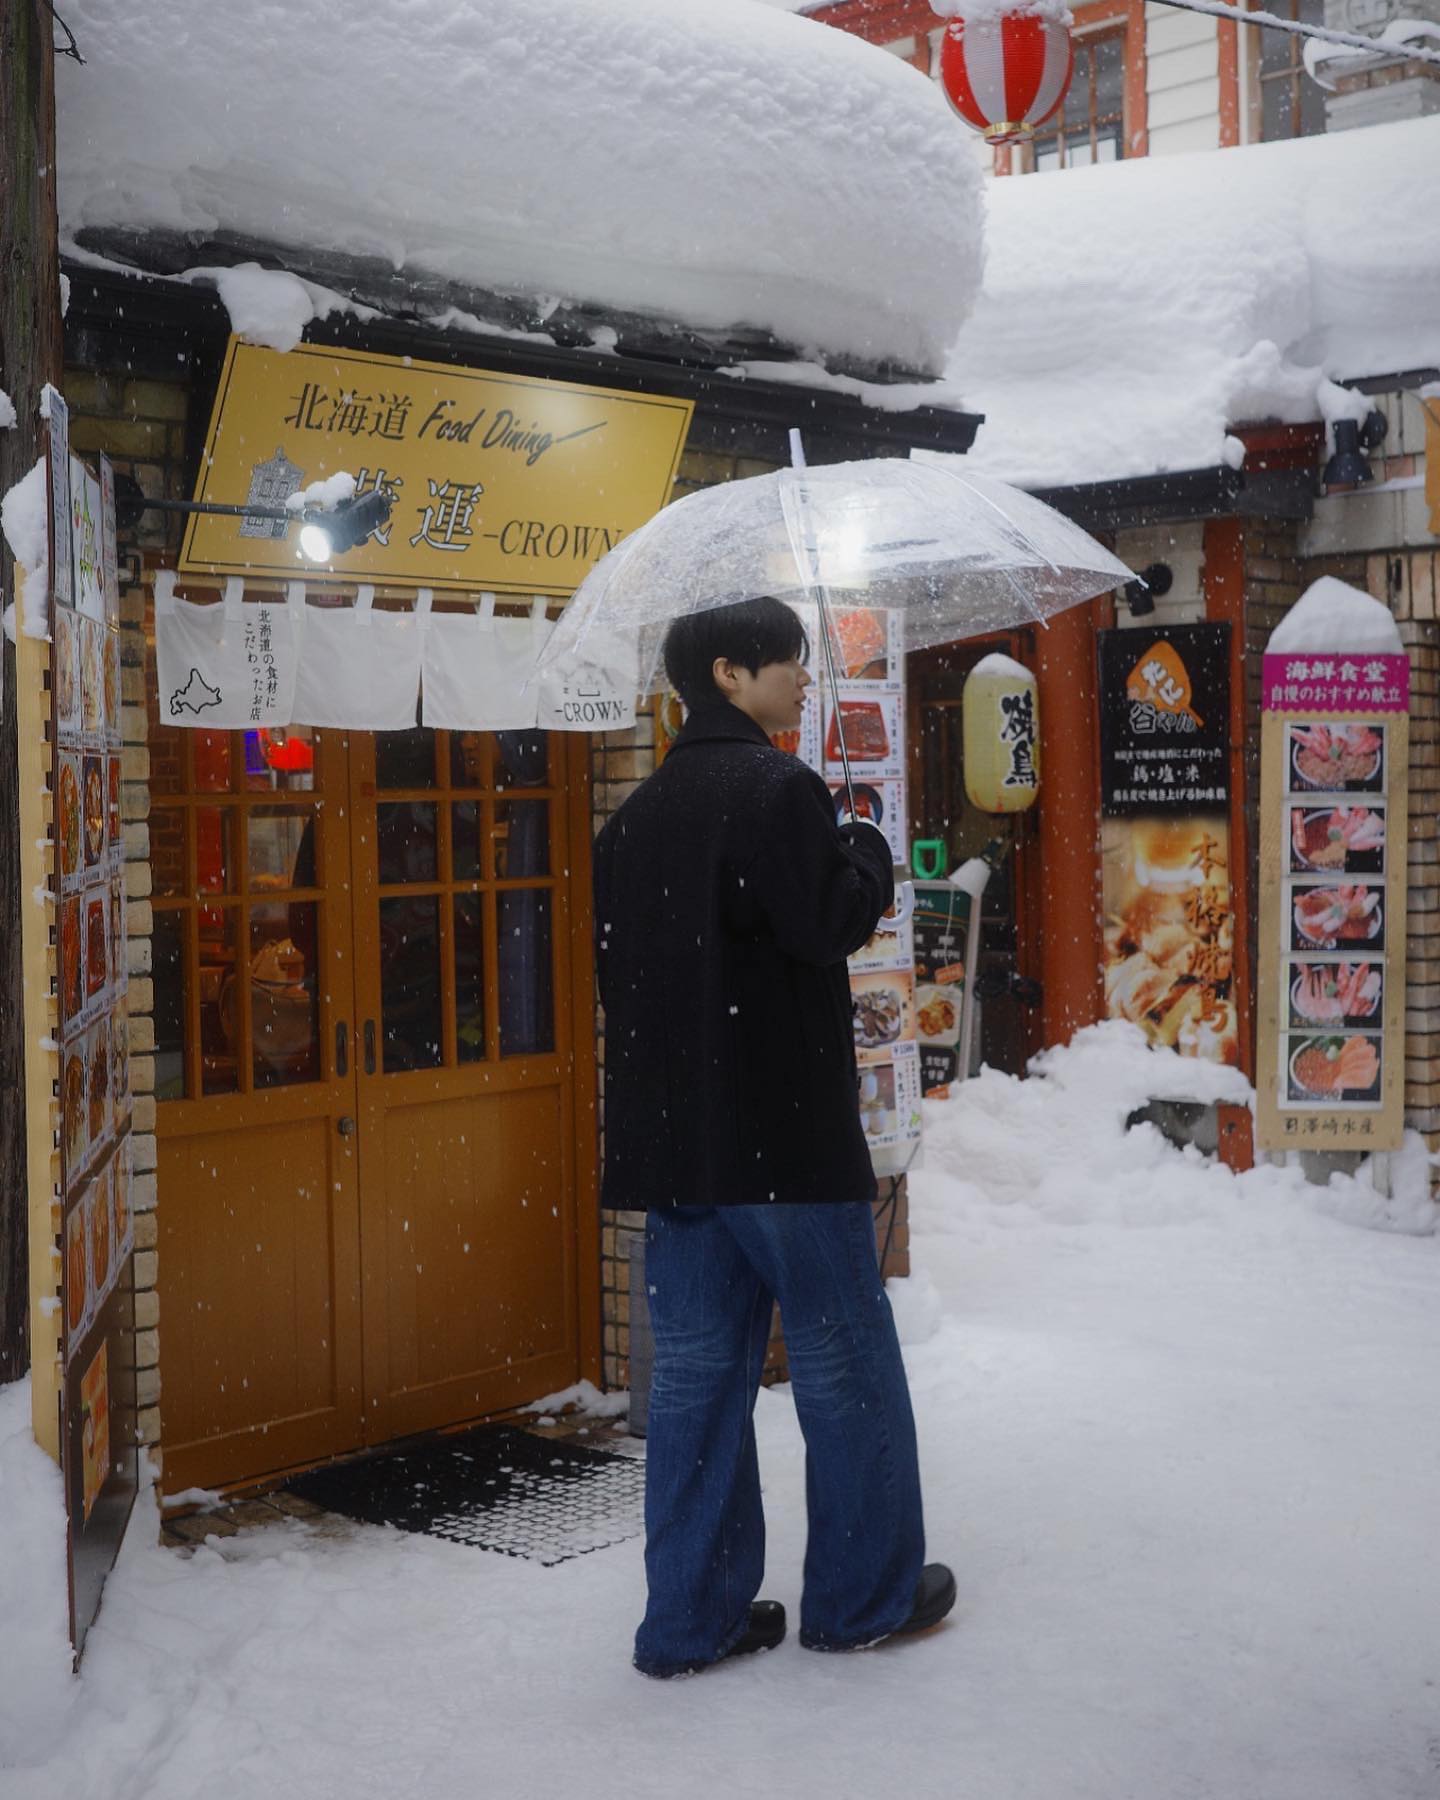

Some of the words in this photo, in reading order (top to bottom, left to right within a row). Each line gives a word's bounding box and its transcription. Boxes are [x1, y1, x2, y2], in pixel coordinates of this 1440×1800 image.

[284, 383, 413, 441] 北海道
[418, 400, 486, 443] Food
[481, 409, 556, 466] Dining
[244, 621, 263, 721] こだわったお店
[258, 608, 279, 709] 北海道の食材に
[1271, 684, 1402, 704] 自慢のおすすめ献立
[1286, 660, 1388, 682] 海鮮食堂
